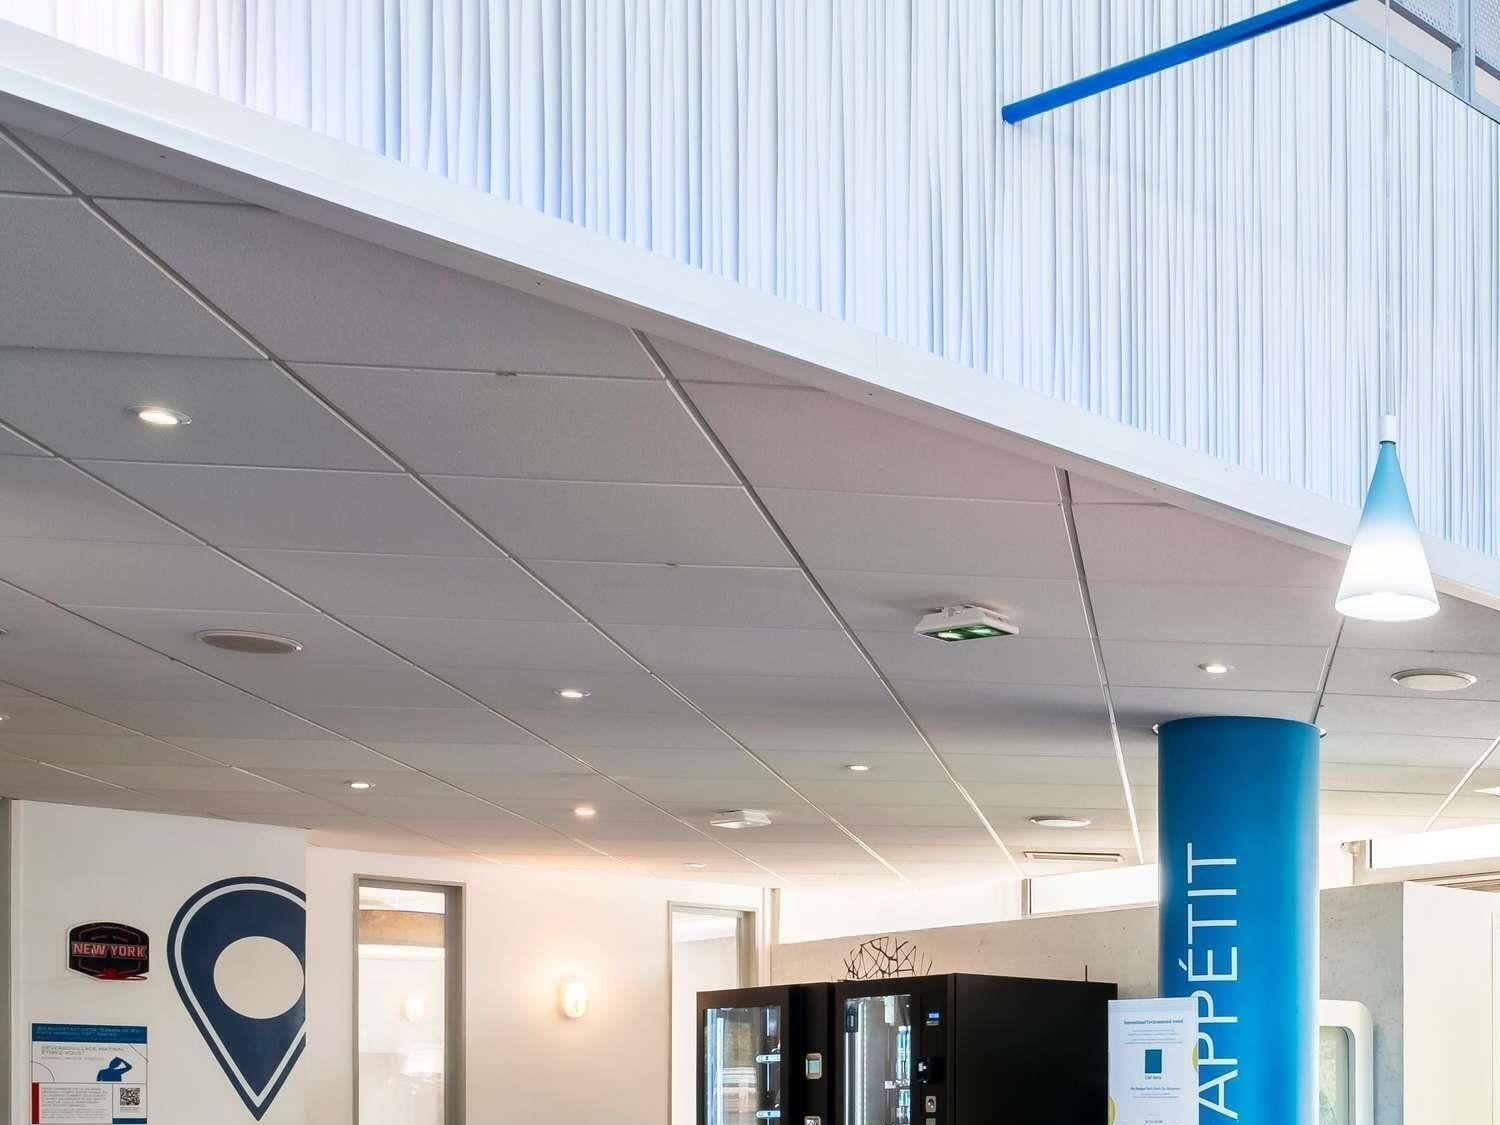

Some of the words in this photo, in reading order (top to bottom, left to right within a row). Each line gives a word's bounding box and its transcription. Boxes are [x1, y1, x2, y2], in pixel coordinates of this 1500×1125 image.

[73, 943, 105, 956] NEW
[110, 944, 145, 957] YORK
[1178, 842, 1239, 1120] APPÉTIT
